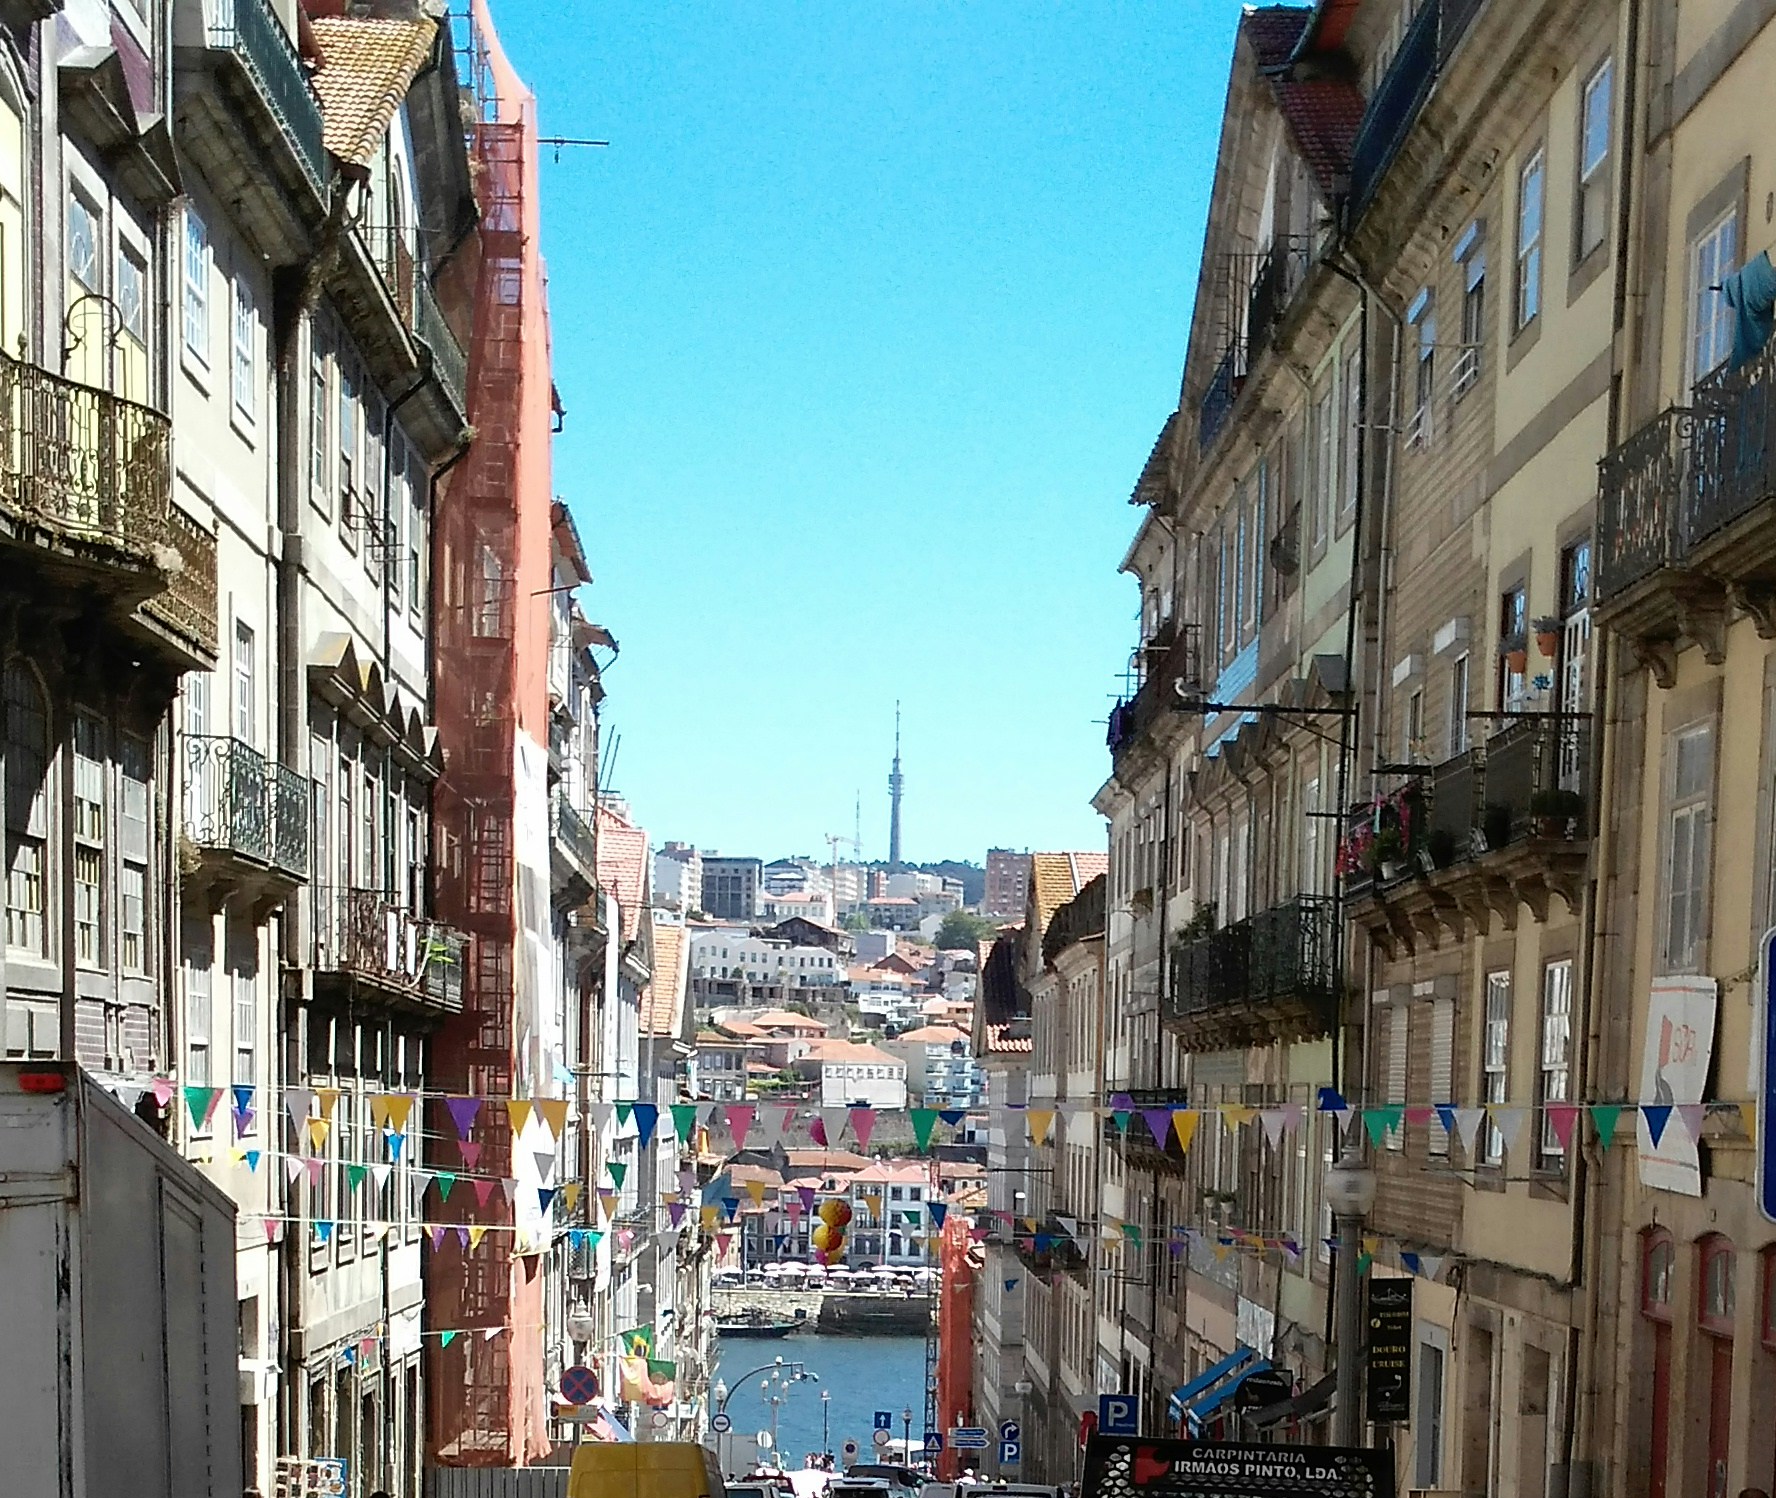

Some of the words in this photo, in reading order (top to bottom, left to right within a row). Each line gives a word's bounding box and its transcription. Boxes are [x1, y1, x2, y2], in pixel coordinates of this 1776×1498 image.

[1192, 1447, 1306, 1464] CARPINTARIA
[1244, 1463, 1302, 1481] PINTO,
[1305, 1466, 1343, 1481] LDA.
